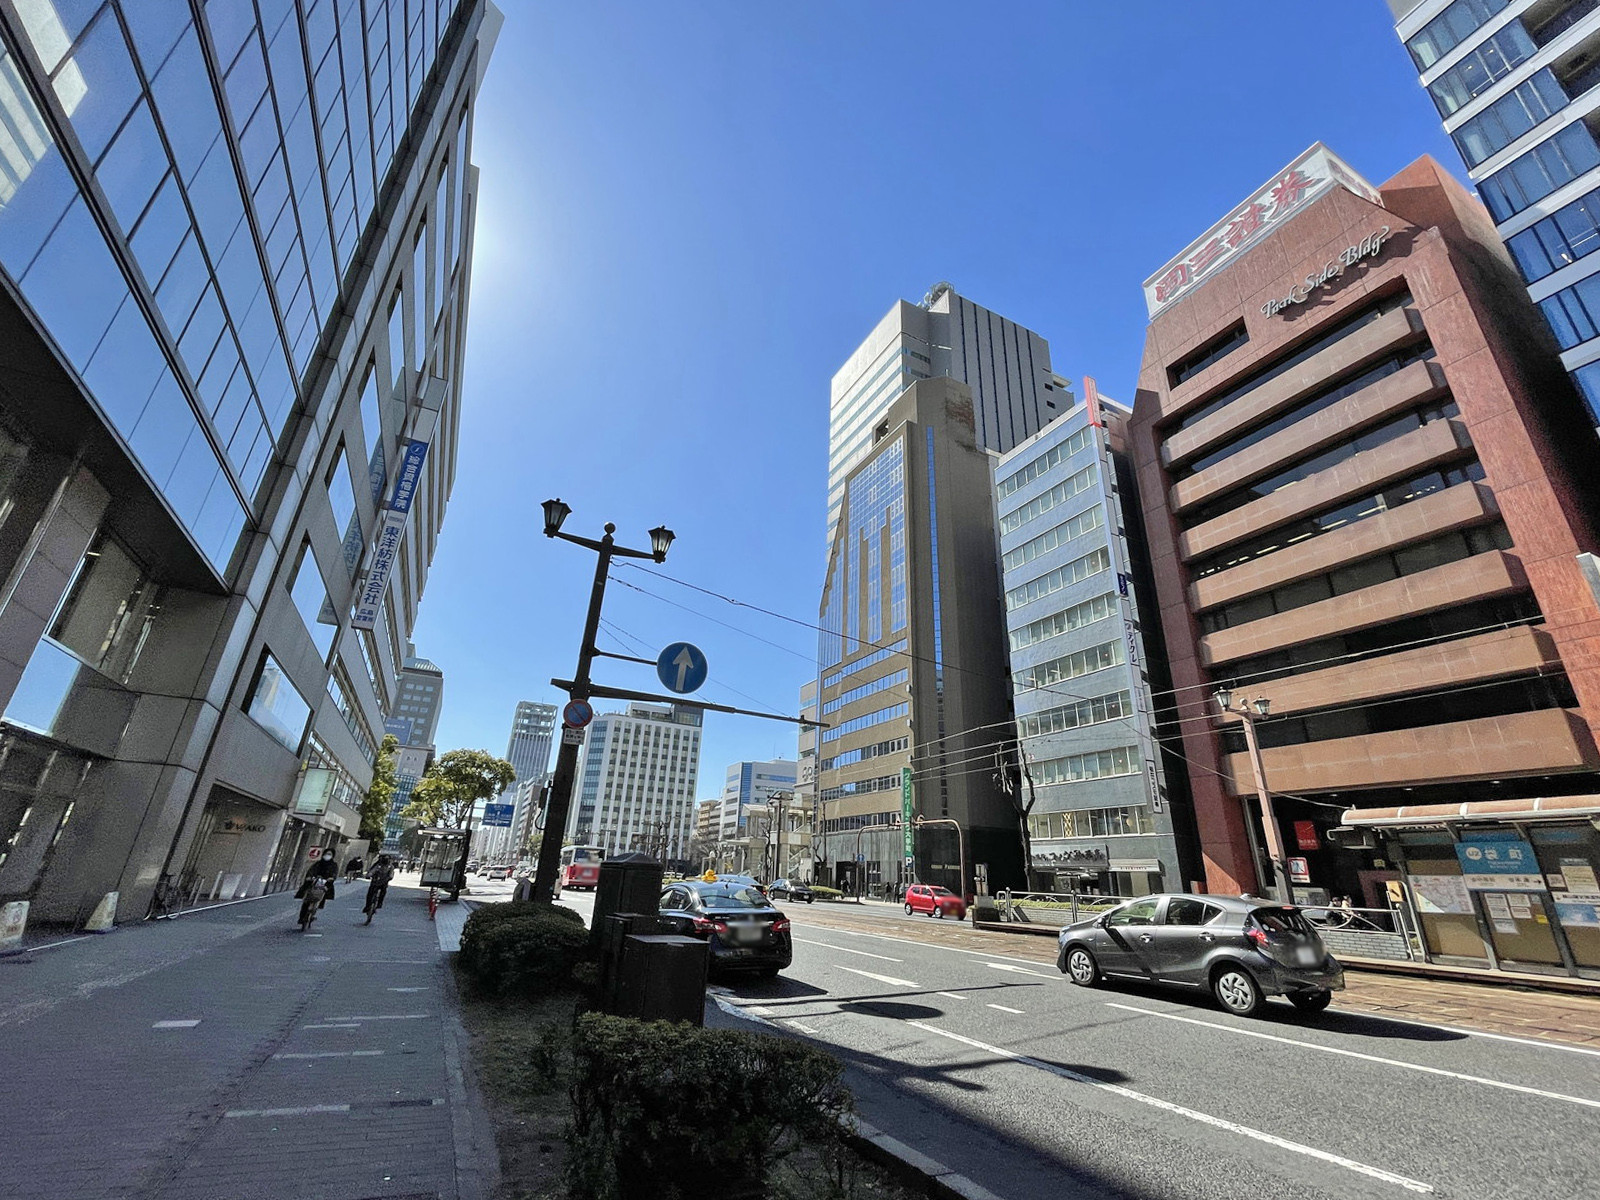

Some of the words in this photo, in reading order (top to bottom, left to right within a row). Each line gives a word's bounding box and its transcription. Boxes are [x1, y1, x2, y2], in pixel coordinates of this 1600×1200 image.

[1260, 284, 1308, 319] Park
[1301, 260, 1339, 294] Side
[363, 525, 400, 606] 東洋紡株式会社
[905, 857, 913, 866] P
